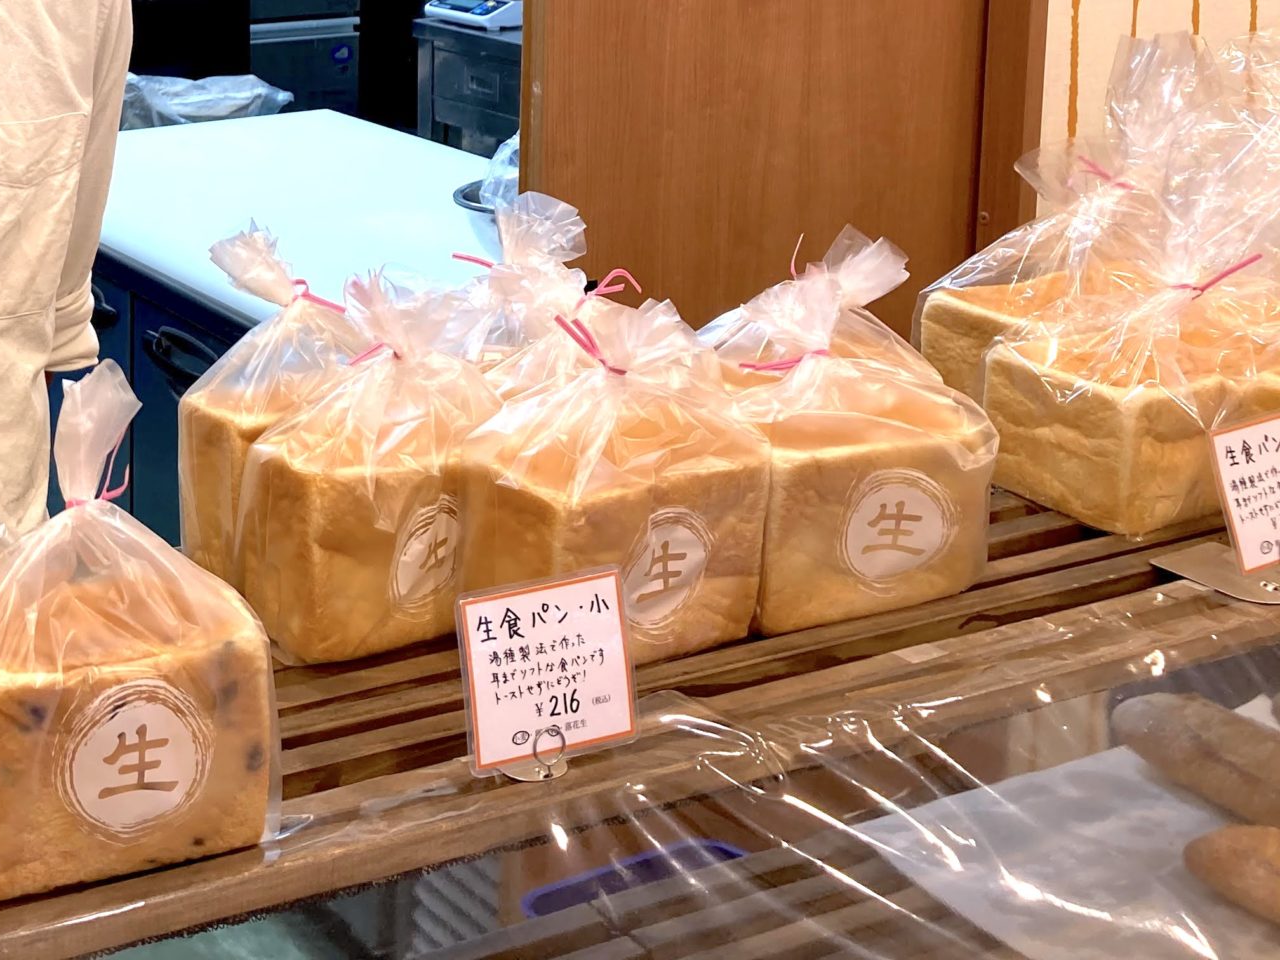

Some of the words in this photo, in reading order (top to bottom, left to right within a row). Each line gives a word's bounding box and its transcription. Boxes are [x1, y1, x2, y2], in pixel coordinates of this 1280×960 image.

[867, 501, 926, 556] 生
[636, 541, 687, 604] 生
[476, 593, 610, 643] 生食パン・小
[488, 633, 586, 666] 湯種製法で作った
[98, 723, 179, 800] 生
